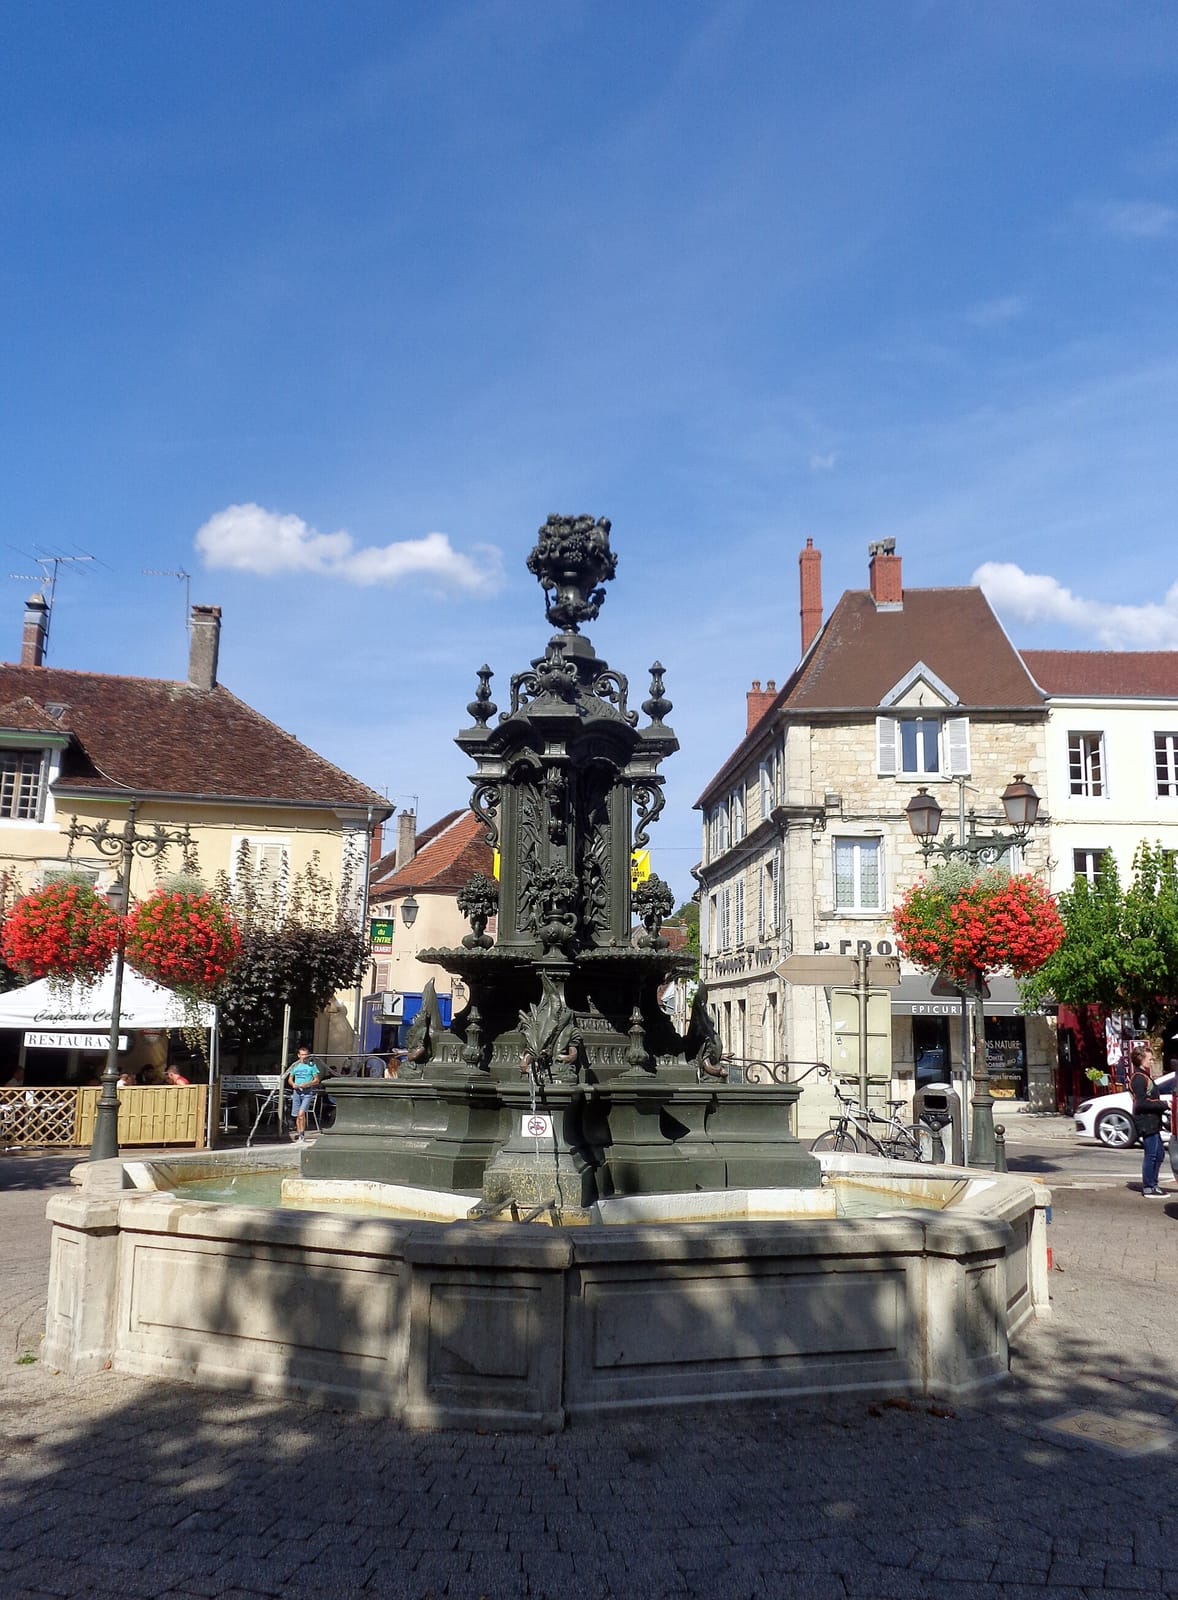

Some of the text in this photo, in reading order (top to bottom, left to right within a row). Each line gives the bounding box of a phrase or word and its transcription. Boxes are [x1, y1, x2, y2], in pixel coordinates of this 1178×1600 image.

[372, 936, 392, 944] ENTRE
[70, 1012, 89, 1020] du
[92, 1009, 135, 1022] Cere
[27, 1033, 126, 1047] RESTAURAN
